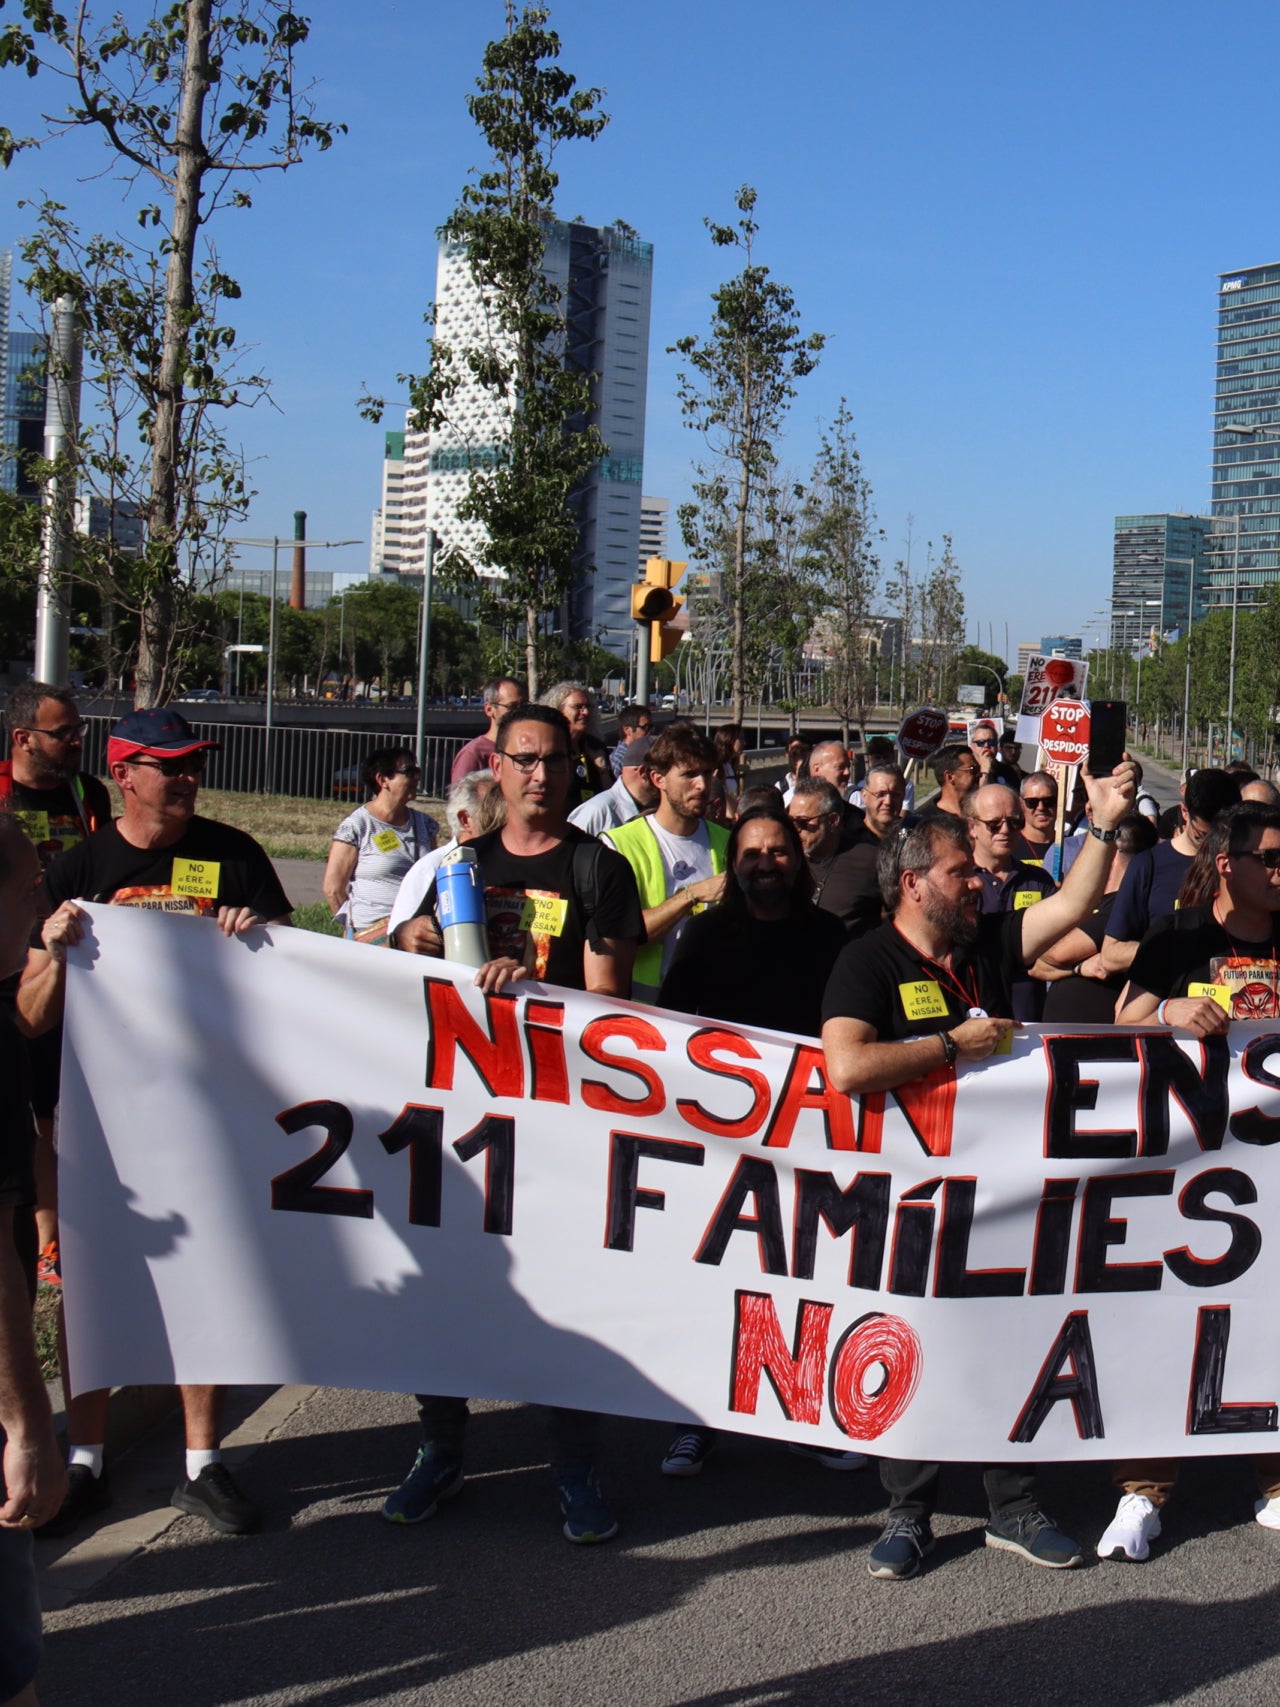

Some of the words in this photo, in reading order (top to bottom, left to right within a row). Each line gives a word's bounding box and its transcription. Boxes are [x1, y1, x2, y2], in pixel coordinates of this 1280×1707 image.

[1222, 280, 1242, 291] KPMG
[1030, 657, 1045, 669] NO
[1028, 671, 1046, 681] ERE
[1027, 685, 1059, 705] 211
[1050, 706, 1085, 722] STOP
[916, 715, 943, 729] STOP
[1043, 738, 1089, 754] DESPIDOS
[188, 863, 205, 873] NO
[185, 875, 204, 884] ERE
[177, 885, 213, 895] NISSAN
[141, 901, 163, 911] PARA
[164, 901, 194, 911] NISSAN
[535, 911, 550, 921] ERE
[525, 920, 557, 932] NISSAN
[1224, 970, 1248, 980] FUTURO
[1248, 970, 1265, 980] PARA
[914, 984, 929, 994] NO
[1202, 987, 1217, 997] NO
[915, 996, 932, 1005] ERE
[911, 1006, 943, 1017] NISSAN
[270, 1099, 516, 1236] 211
[728, 1289, 924, 1441] NO
[1007, 1309, 1106, 1443] A
